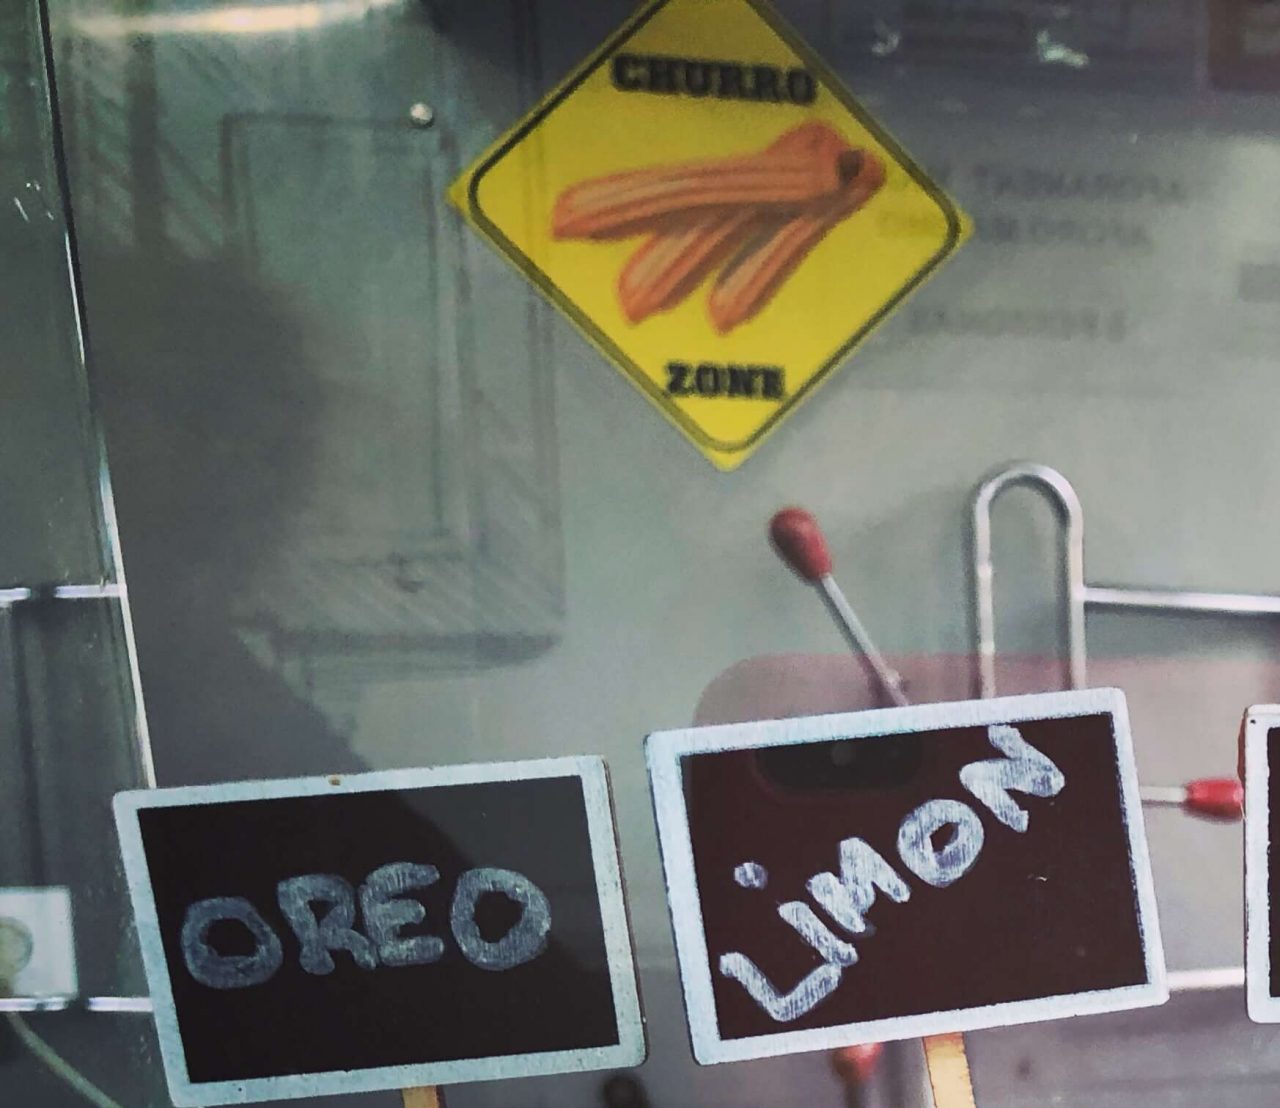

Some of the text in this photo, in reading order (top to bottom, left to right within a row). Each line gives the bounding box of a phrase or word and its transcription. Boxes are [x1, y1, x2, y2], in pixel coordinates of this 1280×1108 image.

[612, 54, 817, 104] CHURRO
[667, 361, 785, 400] ZONE
[180, 861, 551, 990] OREO
